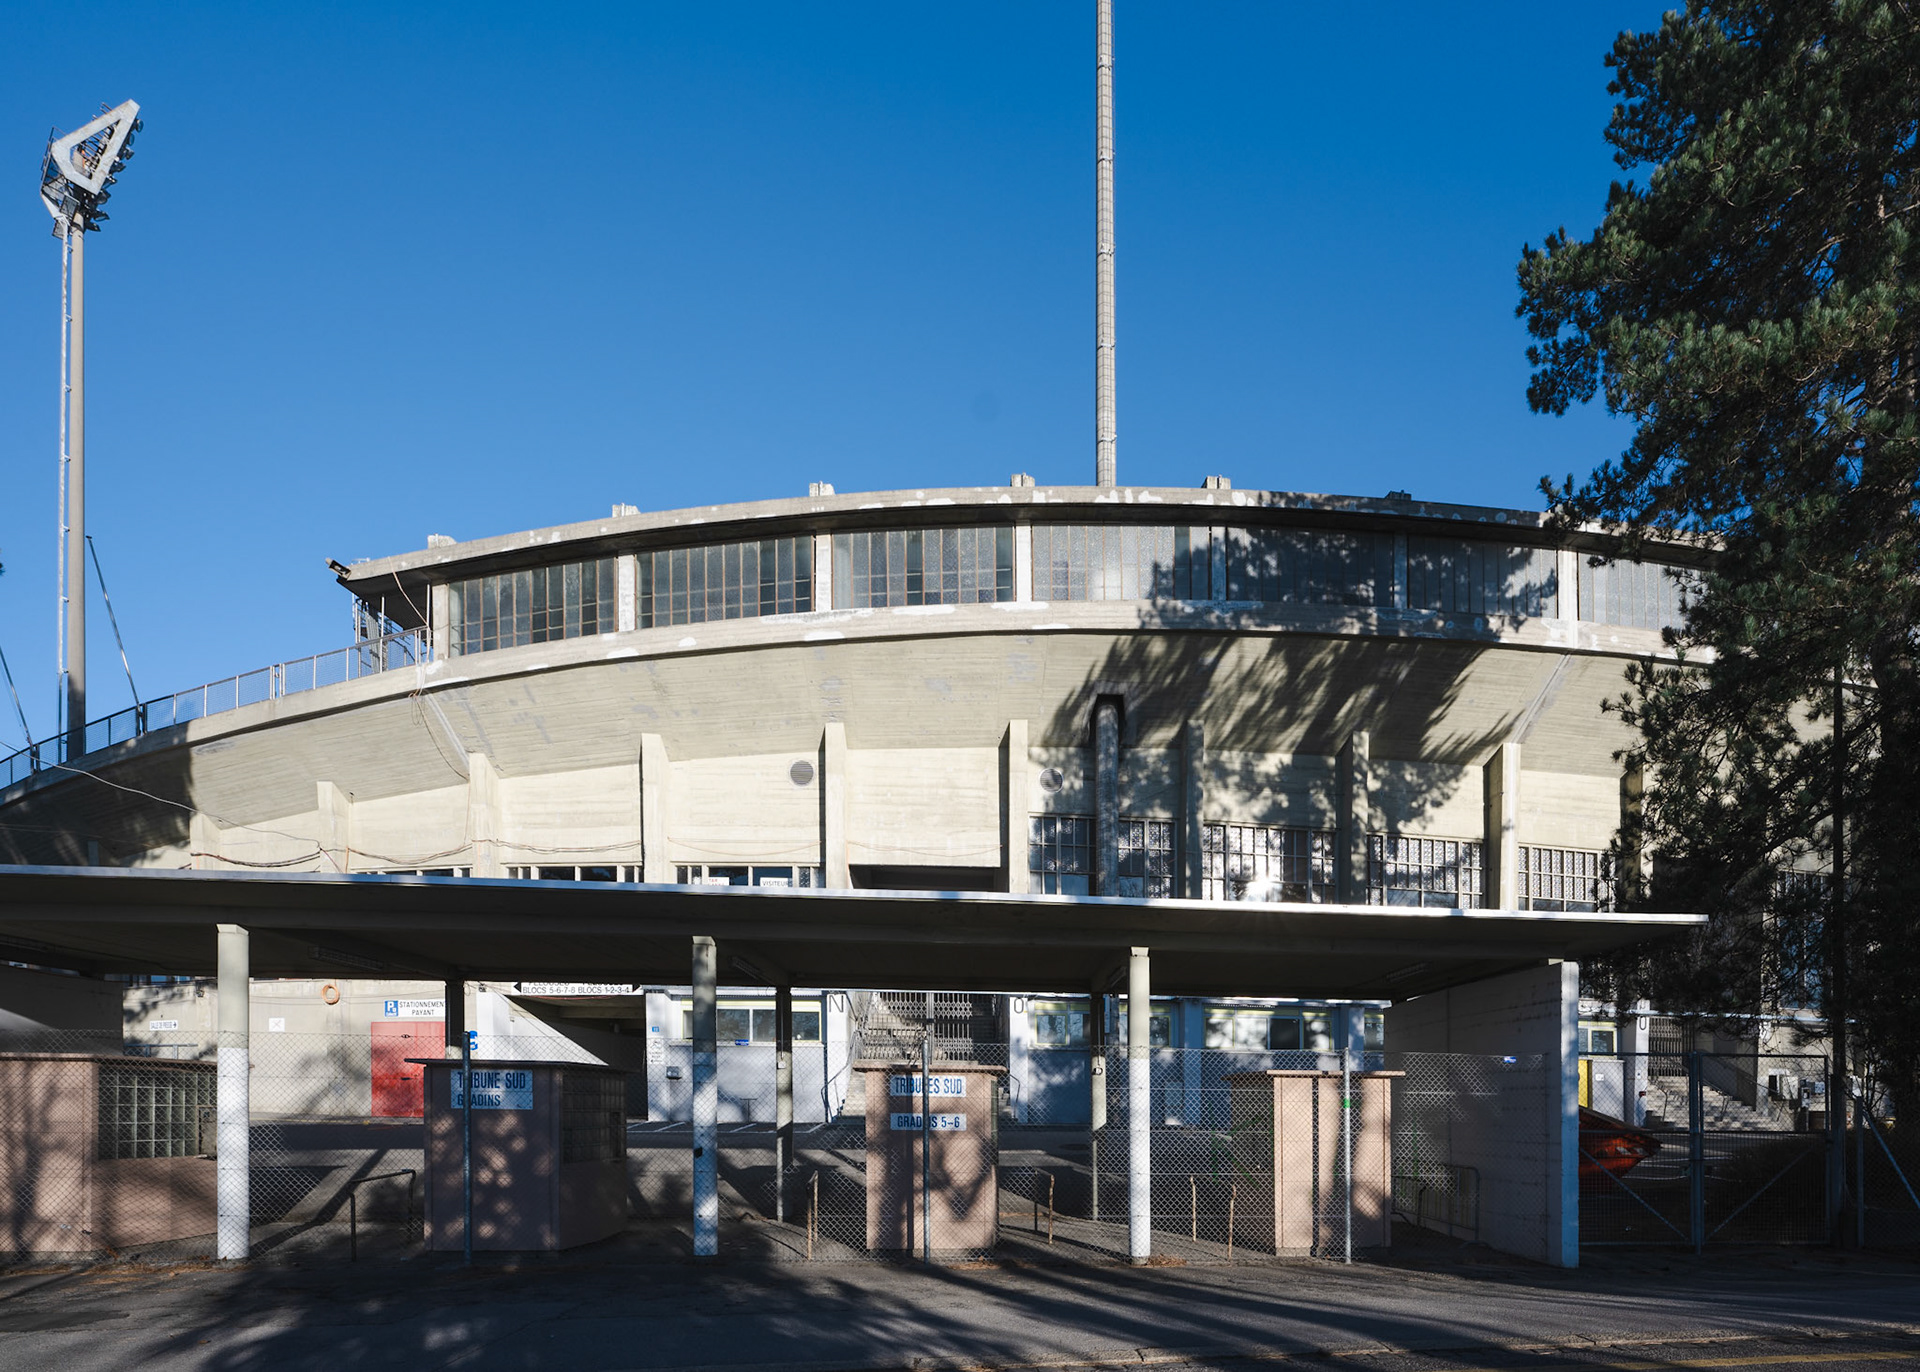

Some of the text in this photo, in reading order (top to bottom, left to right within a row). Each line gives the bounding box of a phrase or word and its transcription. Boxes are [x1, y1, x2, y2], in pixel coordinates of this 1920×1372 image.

[522, 986, 576, 994] BLOCS 5-6-7-8
[578, 986, 630, 994] BLOCS 1-2-3-4
[829, 995, 844, 1013] N
[457, 1071, 526, 1089] TIBUNE SUD
[943, 1078, 962, 1094] SUD
[457, 1094, 501, 1107] GADINS
[897, 1115, 938, 1128] GRADS
